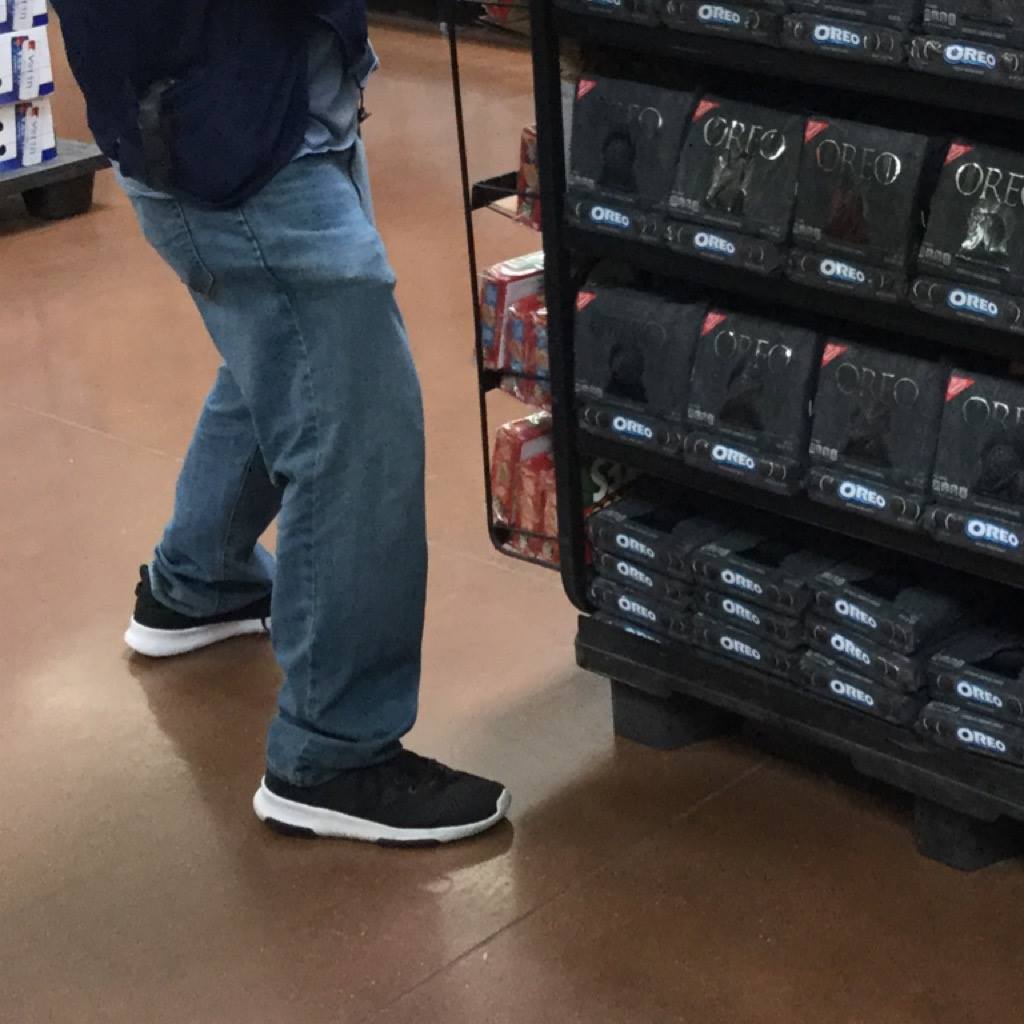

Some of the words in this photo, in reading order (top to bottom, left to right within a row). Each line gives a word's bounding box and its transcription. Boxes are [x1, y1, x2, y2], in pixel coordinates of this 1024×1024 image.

[698, 4, 740, 24] OREO
[814, 25, 860, 45] OREO
[945, 44, 996, 67] OREO
[816, 139, 901, 185] OREO
[591, 206, 630, 226] OREO
[694, 232, 736, 254] OREO
[820, 259, 864, 282] OREO
[949, 290, 998, 315] OREO
[613, 416, 652, 438] OREO
[712, 444, 754, 469] OREO
[839, 482, 885, 508] OREO
[967, 519, 1018, 547] OREO
[616, 534, 655, 558] OREO
[617, 561, 653, 587] OREO
[721, 569, 763, 594] OREO
[618, 596, 656, 621] OREO
[723, 599, 760, 625] OREO
[834, 600, 877, 628] OREO
[720, 636, 761, 660] OREO
[831, 635, 871, 664] OREO
[831, 680, 874, 706] OREO
[957, 680, 1003, 707] OREO
[957, 728, 1006, 752] OREO
